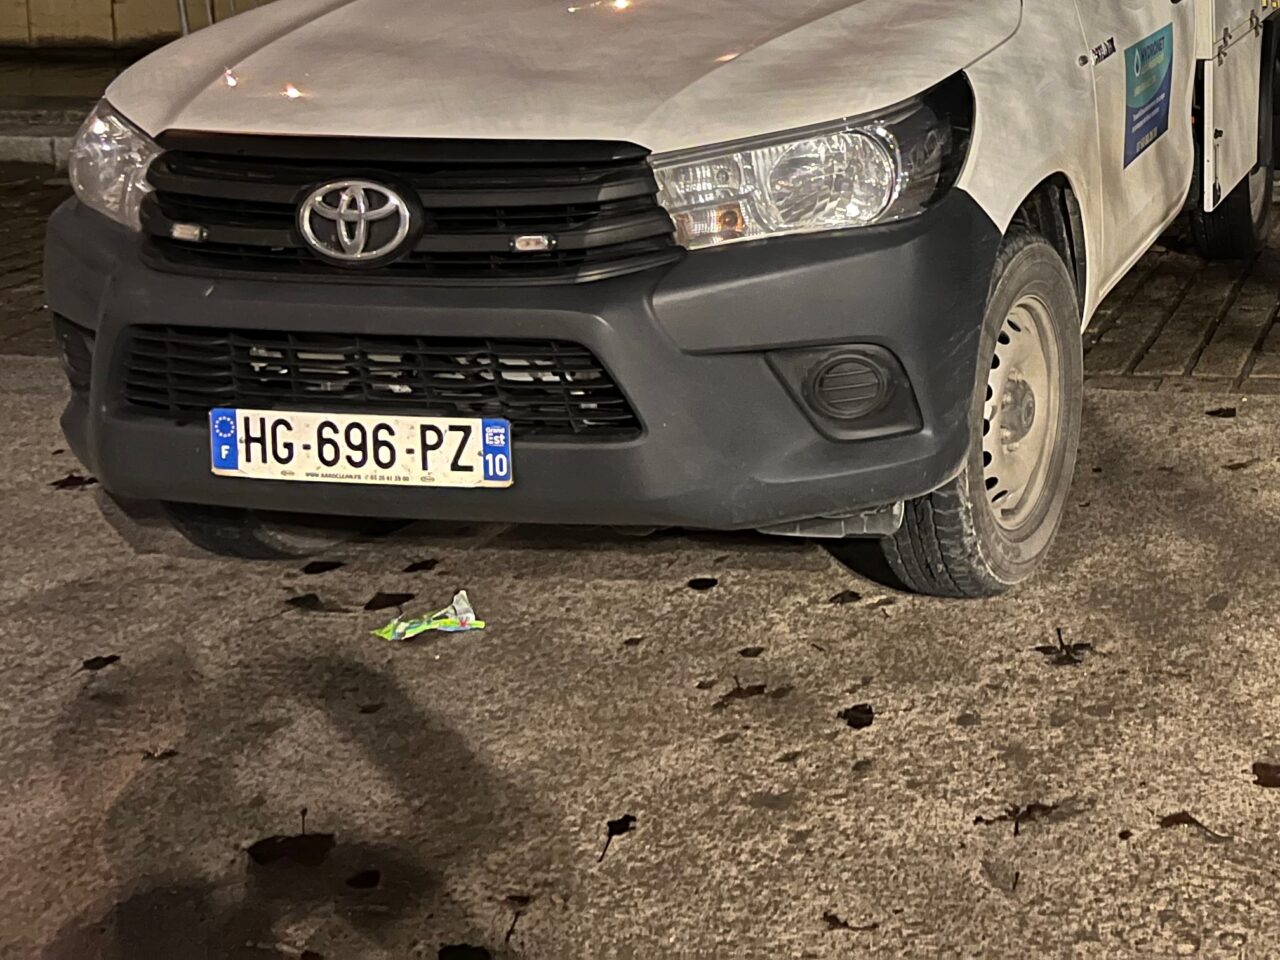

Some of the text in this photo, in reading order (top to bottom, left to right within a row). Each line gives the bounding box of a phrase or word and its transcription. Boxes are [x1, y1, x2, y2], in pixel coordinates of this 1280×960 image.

[485, 426, 505, 435] Grand
[243, 416, 474, 472] HG-696-PZ
[485, 433, 506, 445] Est
[220, 444, 230, 460] F
[485, 453, 508, 477] 10
